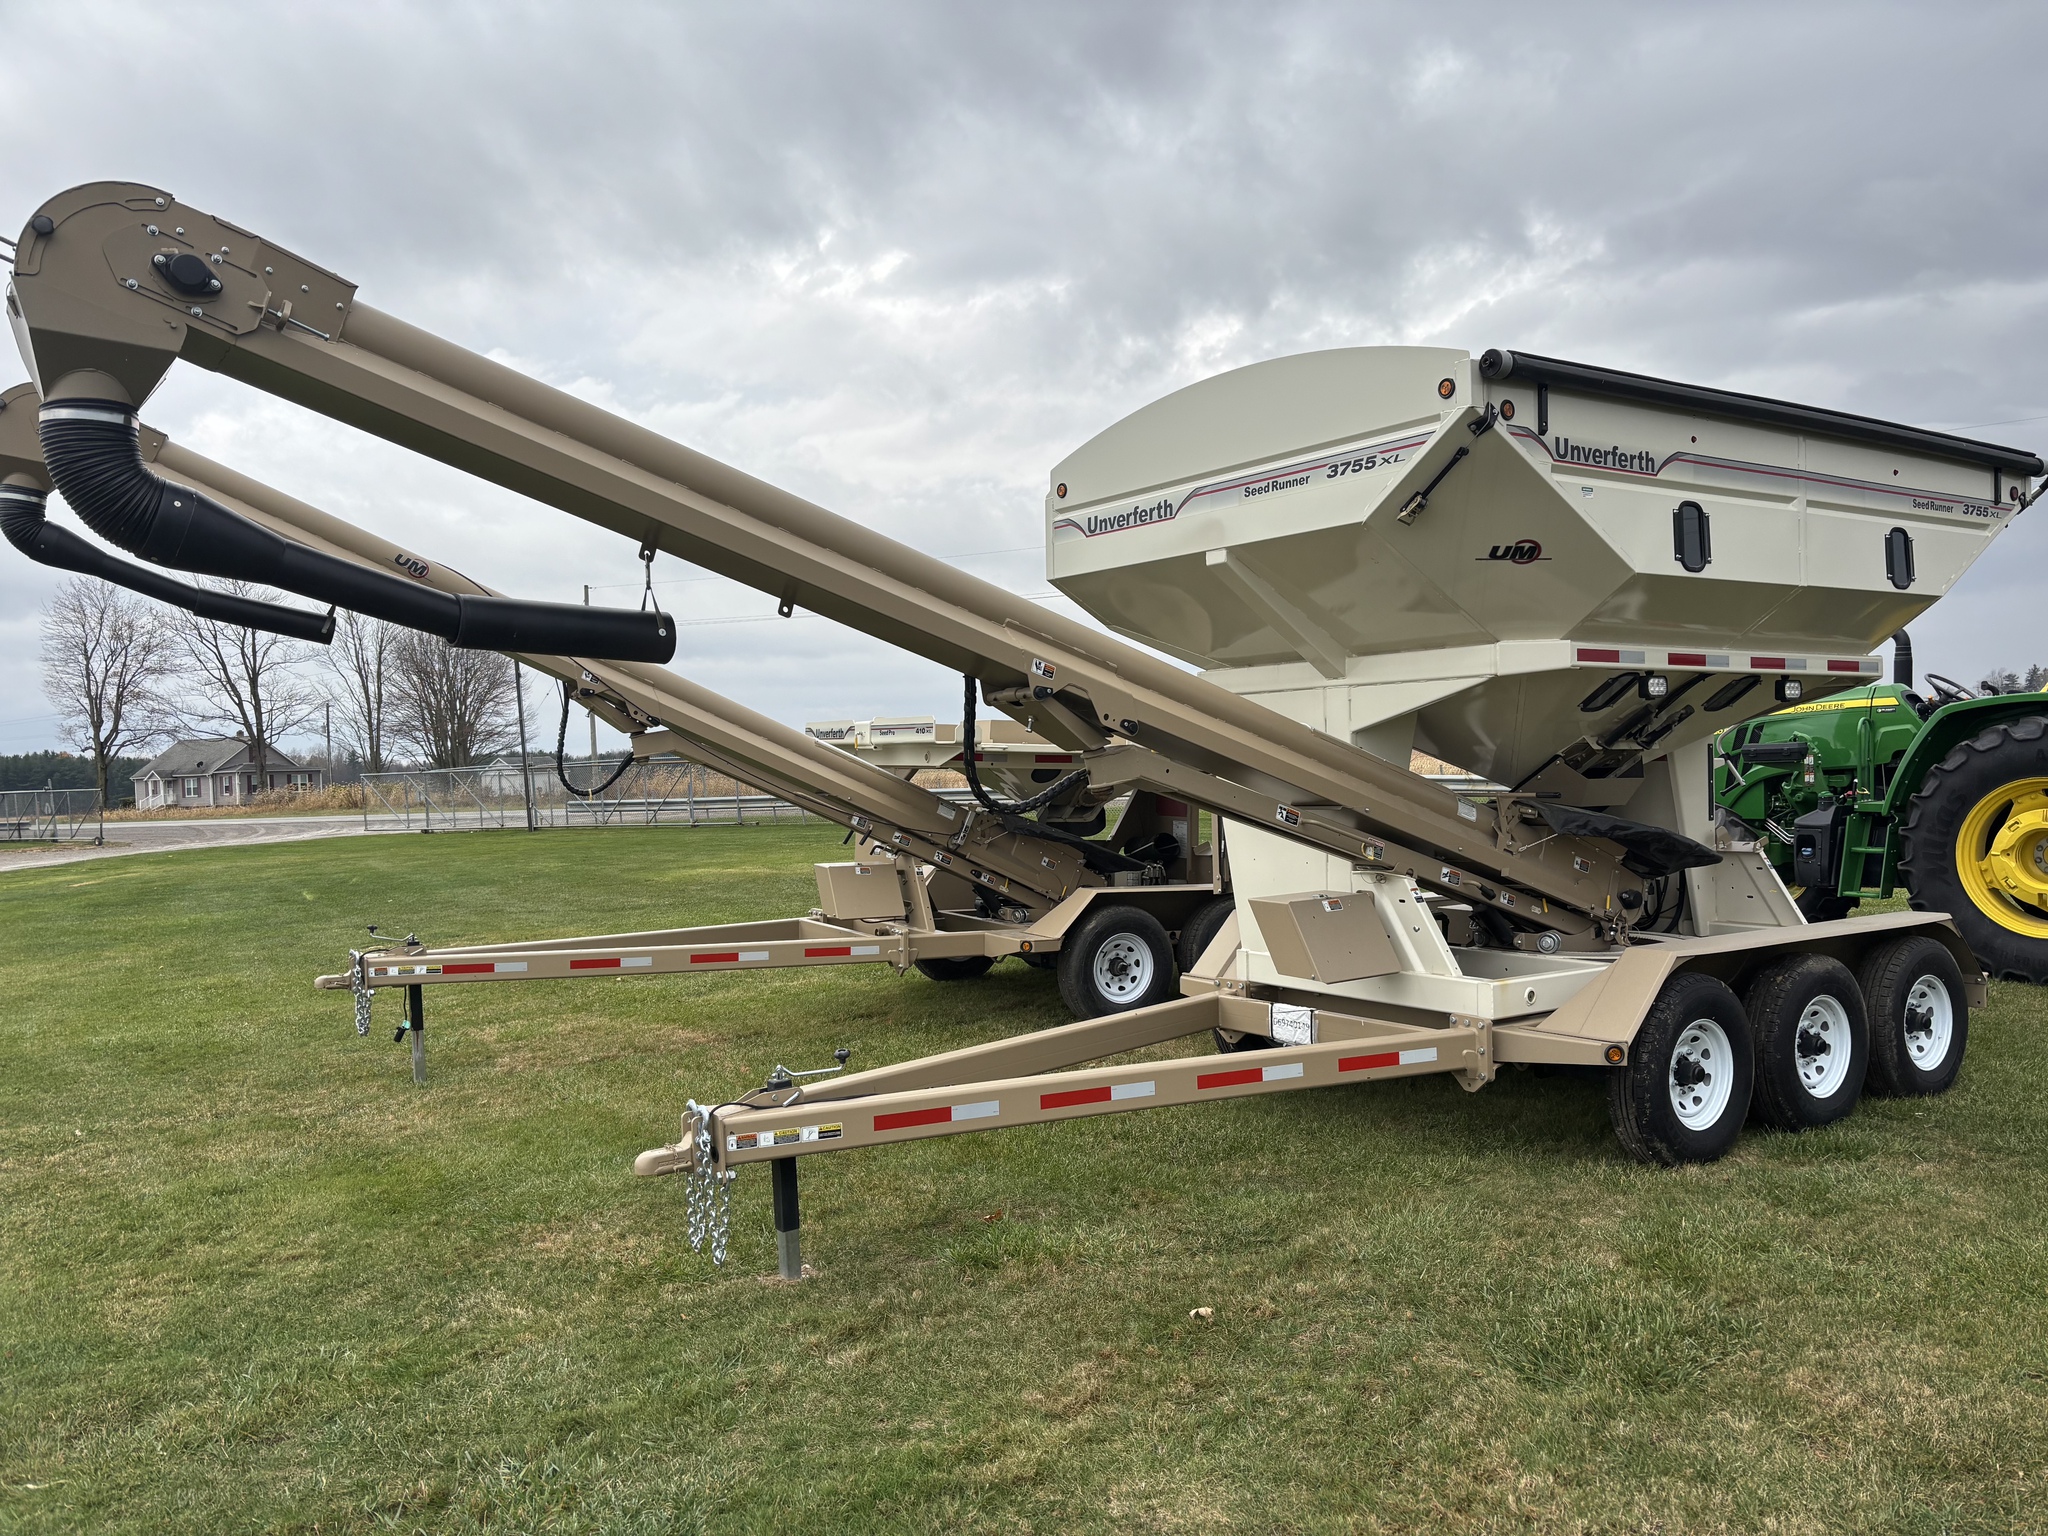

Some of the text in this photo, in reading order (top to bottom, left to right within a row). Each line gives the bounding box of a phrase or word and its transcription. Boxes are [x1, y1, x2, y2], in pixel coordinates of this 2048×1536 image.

[1555, 436, 1655, 473] Unverferth
[1326, 455, 1377, 479] 3755
[1087, 499, 1173, 534] Unverferth
[1962, 503, 1989, 518] 3755
[1791, 702, 1846, 714] JOHN DEERE
[815, 727, 844, 738] Unverferth
